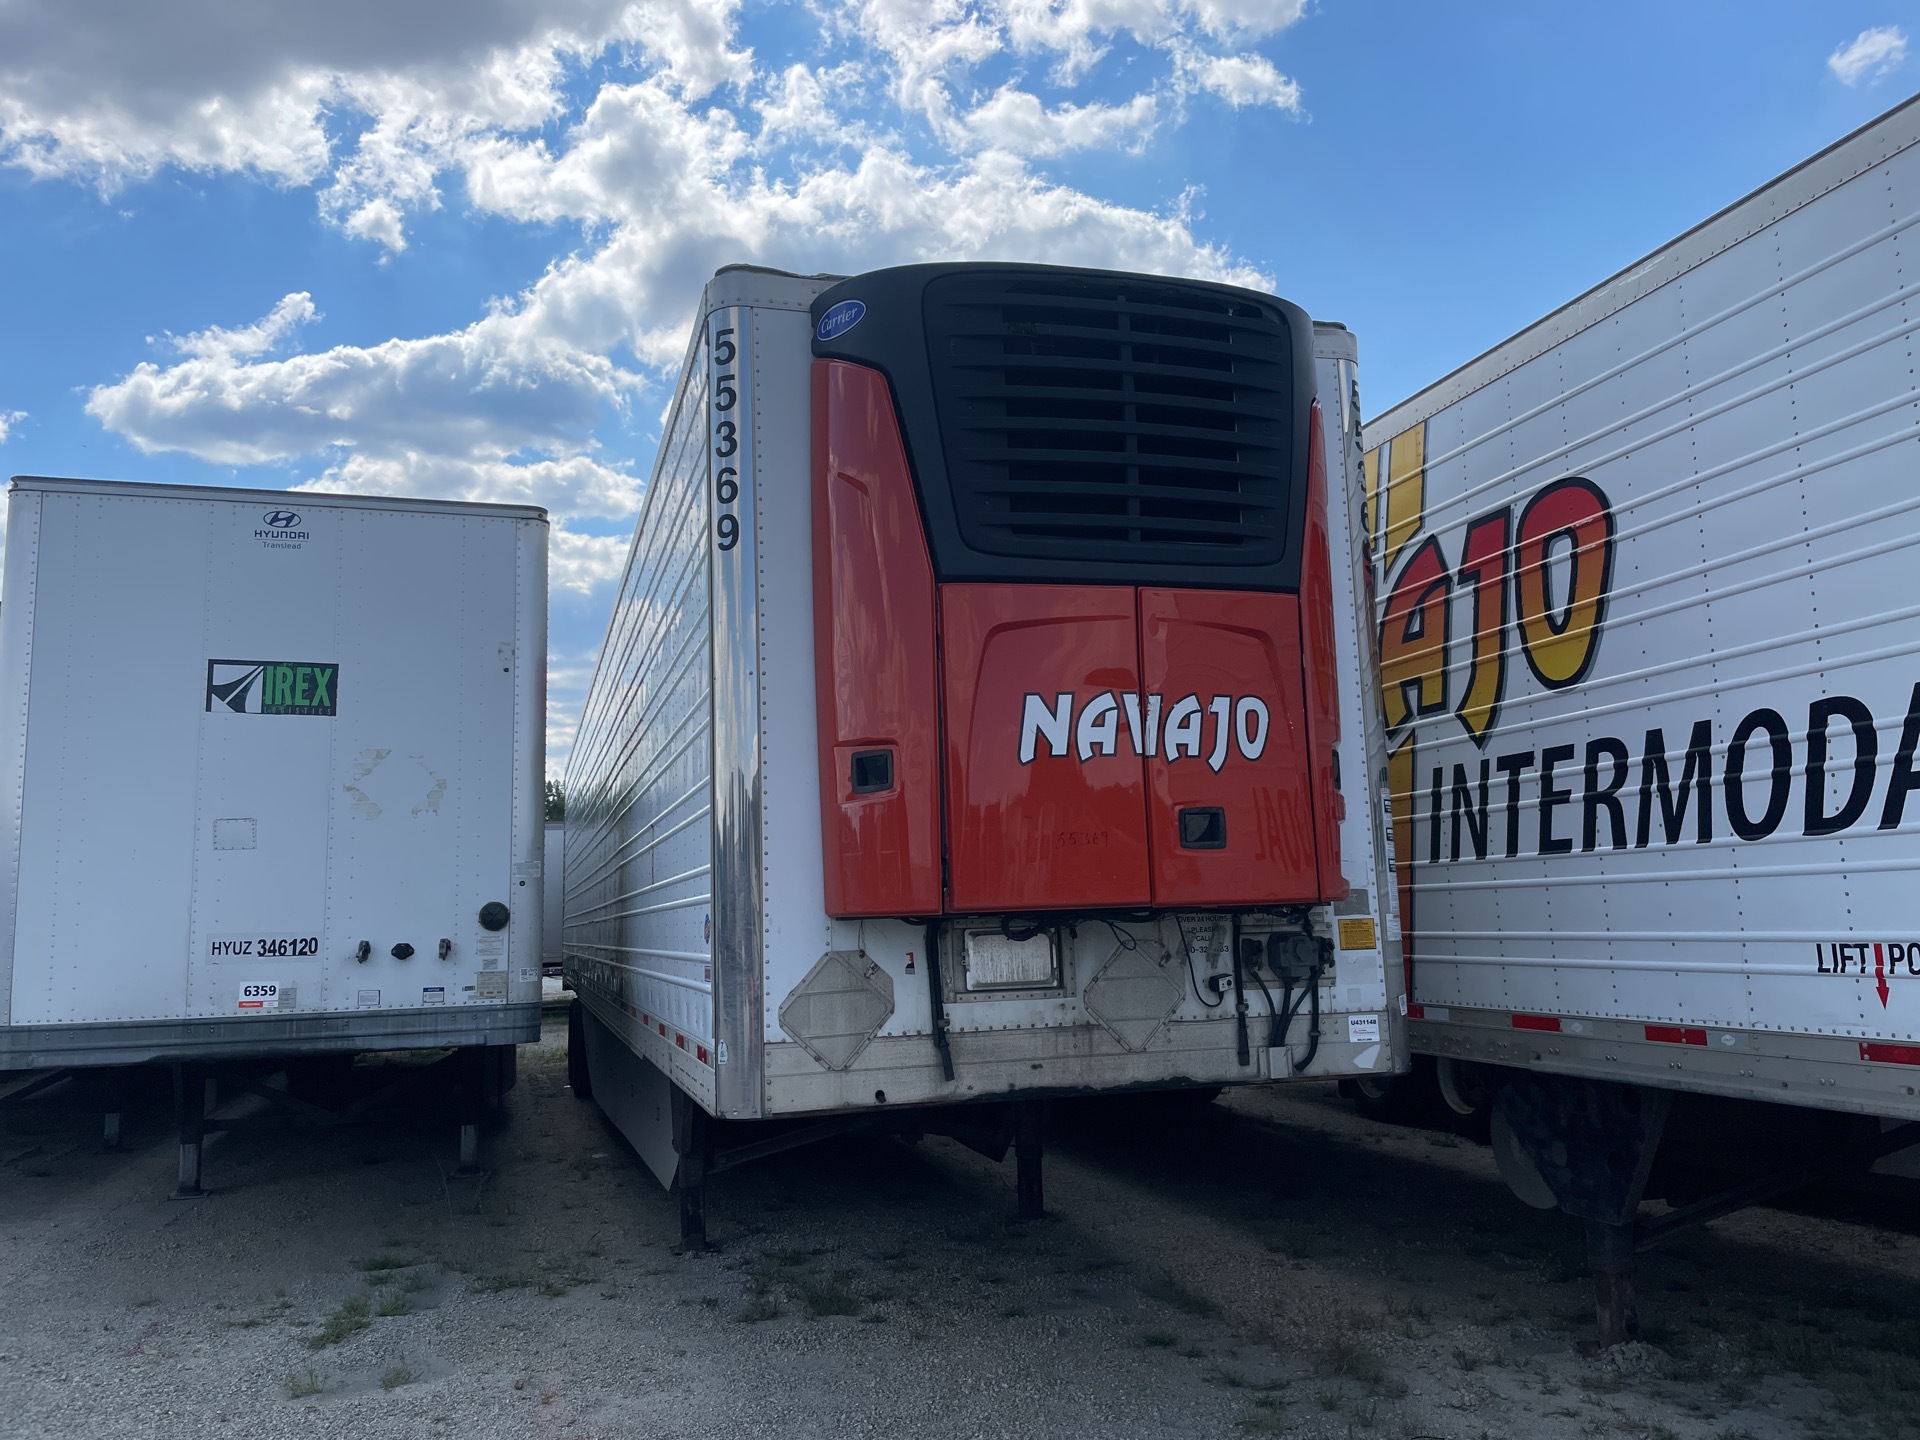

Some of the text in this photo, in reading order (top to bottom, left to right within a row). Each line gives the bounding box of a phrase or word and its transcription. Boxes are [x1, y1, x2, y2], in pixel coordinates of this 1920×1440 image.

[821, 308, 858, 334] Carrier
[714, 328, 740, 551] 55369
[254, 530, 310, 540] HYUNDAI
[262, 541, 302, 550] Translead
[264, 665, 333, 707] IREX
[264, 706, 332, 715] LOGISTICS
[1018, 689, 1270, 776] NAVAJO
[211, 937, 318, 957] HYUZ 346120
[1816, 943, 1870, 975] LIFT
[244, 985, 277, 997] 6359
